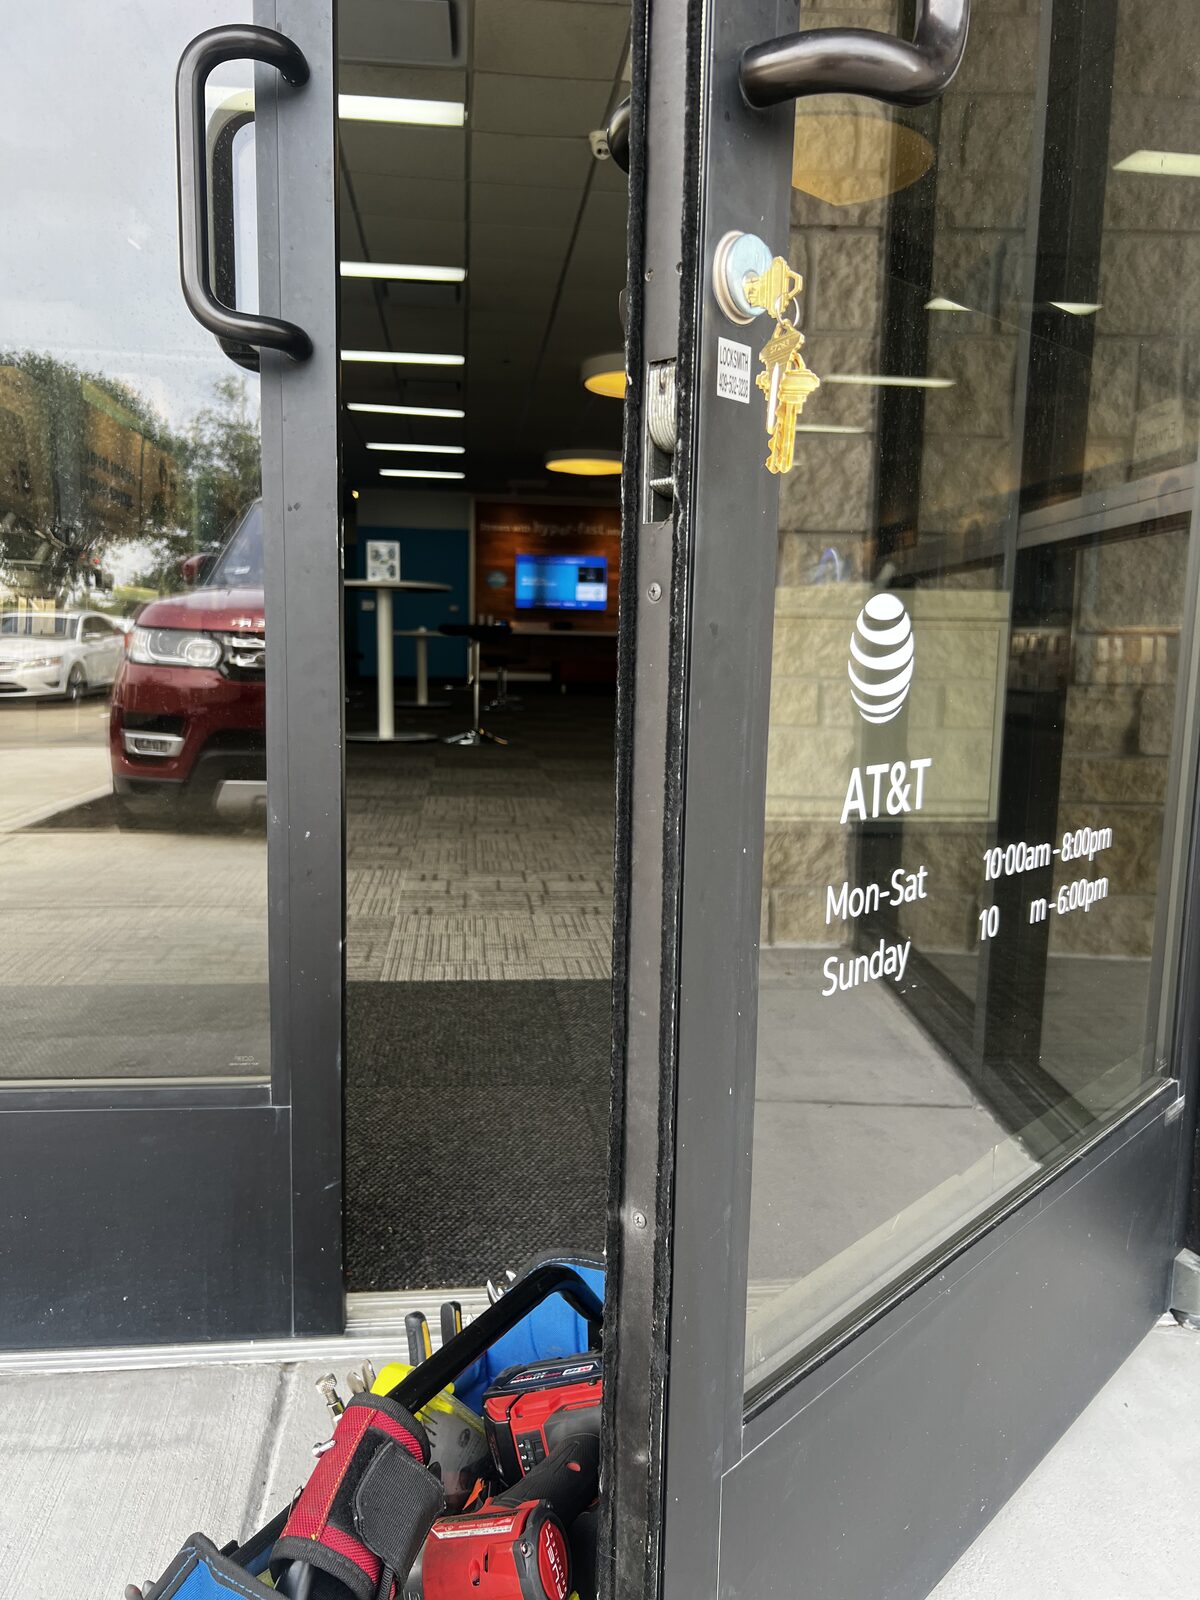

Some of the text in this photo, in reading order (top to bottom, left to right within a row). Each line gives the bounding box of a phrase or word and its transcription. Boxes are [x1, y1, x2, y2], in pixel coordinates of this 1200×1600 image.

[719, 346, 749, 371] LOCKSMITH
[840, 758, 932, 824] AT&T
[825, 865, 928, 924] Mon-Sat
[821, 939, 911, 996] Sunday
[979, 905, 999, 940] 10
[545, 1529, 564, 1599] FUEL
